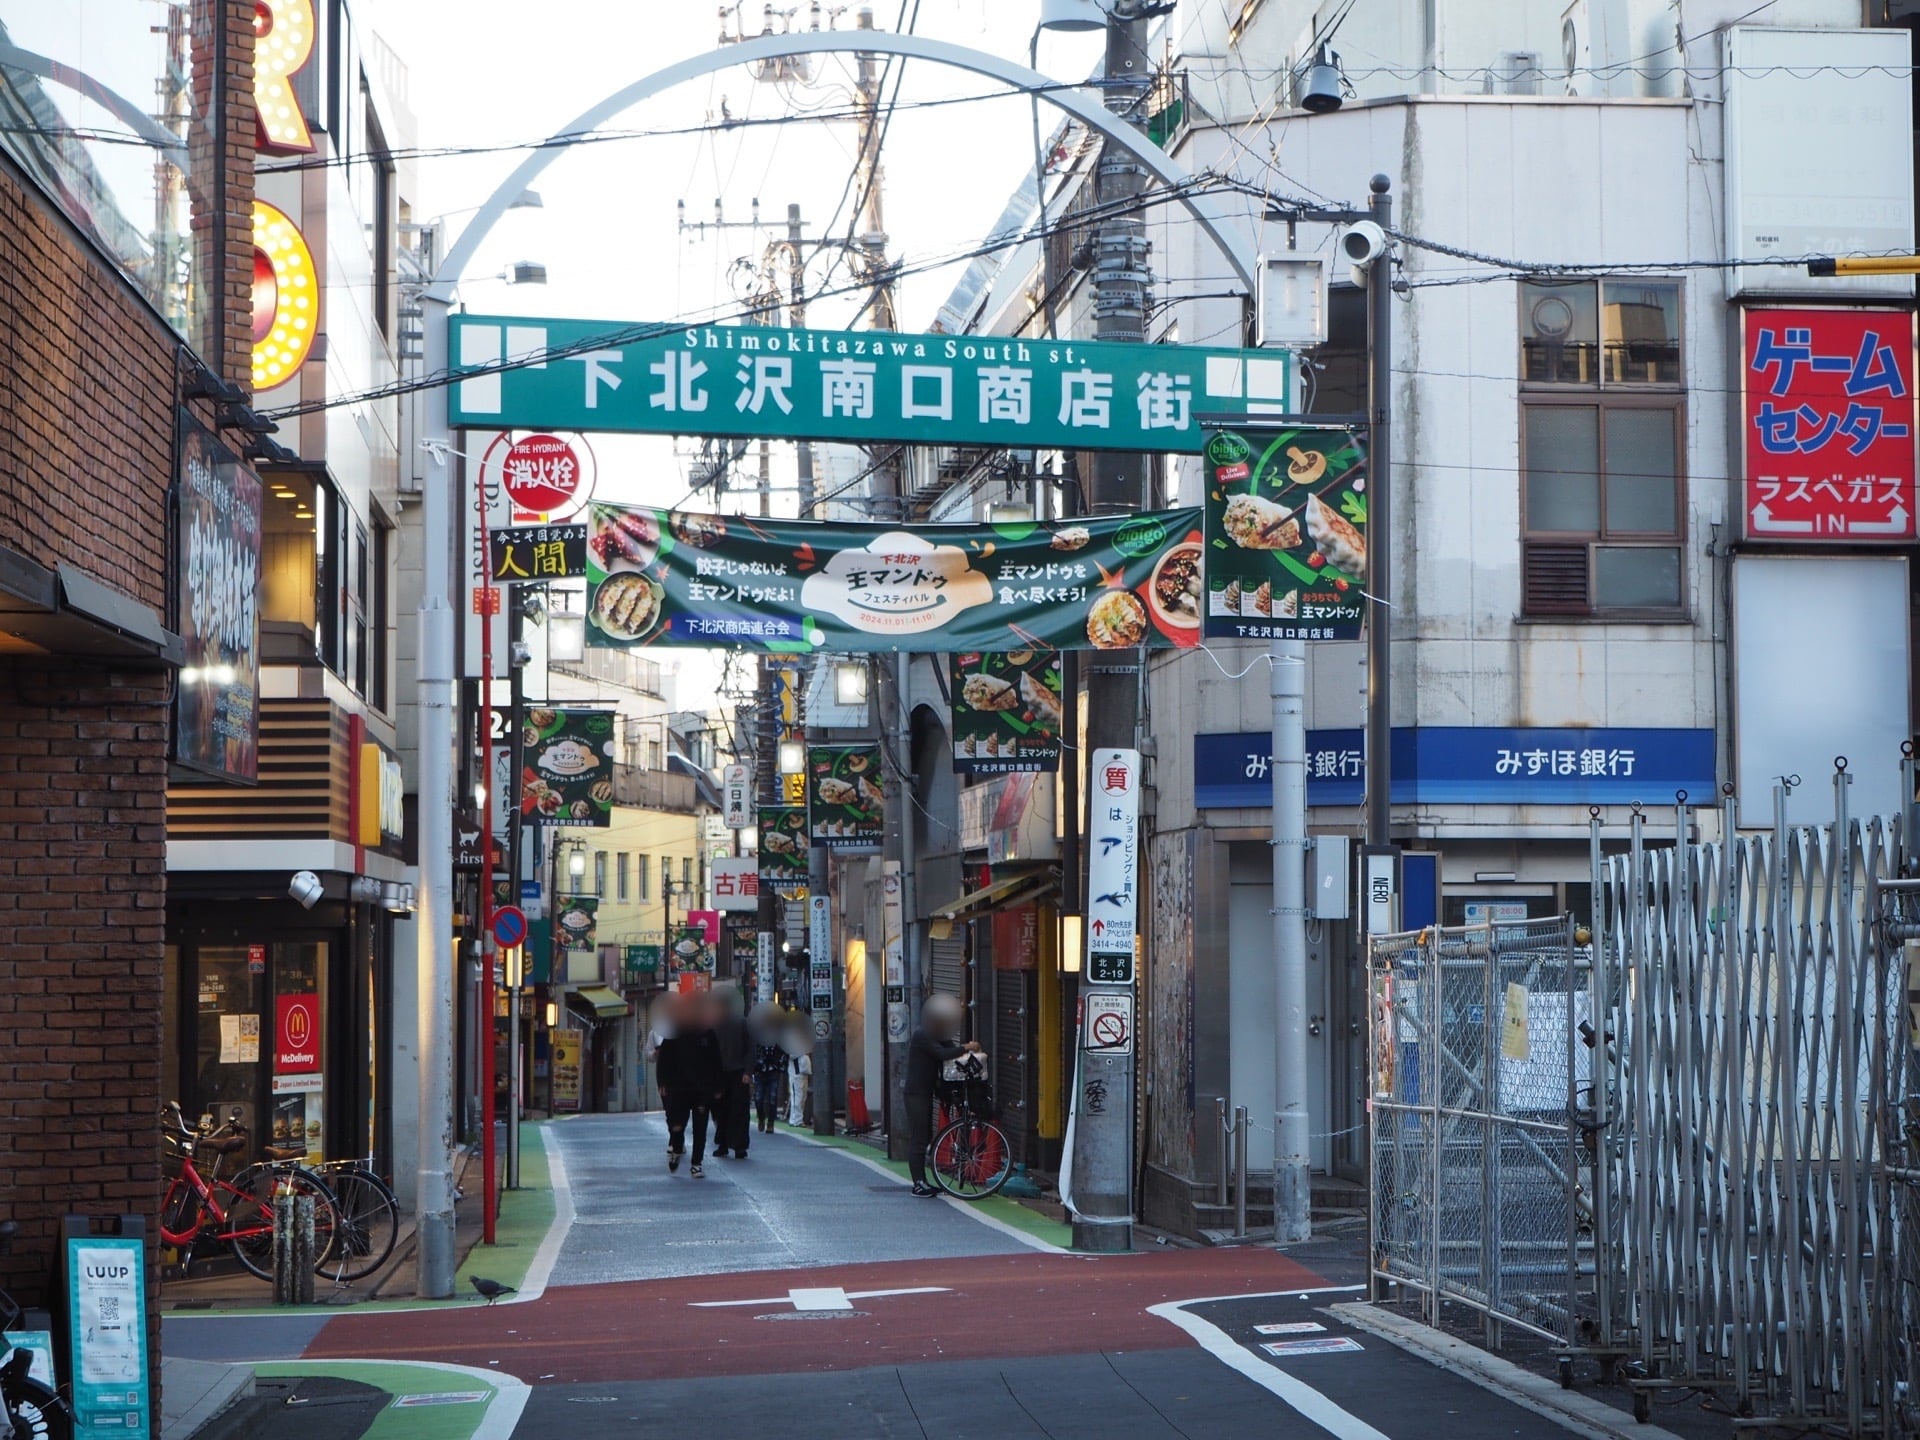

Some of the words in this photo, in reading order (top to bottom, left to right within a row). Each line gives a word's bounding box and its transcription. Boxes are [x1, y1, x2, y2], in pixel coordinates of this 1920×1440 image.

[685, 328, 927, 358] Shimokitazawa
[944, 339, 1031, 363] South
[1049, 348, 1087, 365] st.
[1750, 328, 1907, 399] ゲーム
[569, 350, 1193, 431] 下北沢南口商店街
[1754, 402, 1909, 457] センター
[514, 444, 531, 454] FIRE
[532, 443, 567, 454] HYDRANT
[1212, 441, 1247, 458] bibigo
[508, 456, 576, 490] 消火栓
[1756, 474, 1906, 504] ラスベガス
[1816, 513, 1845, 534] IN
[1117, 527, 1163, 545] bibigo
[496, 541, 567, 577] 人間
[696, 557, 788, 577] 餃子じゃないよ
[880, 554, 922, 566] 下北沢
[845, 569, 949, 591] 王マンドゥ
[998, 563, 1087, 581] 王マンドゥを
[688, 583, 795, 602] 王マンドゥだよ!
[863, 593, 931, 605] フェスティバル
[998, 586, 1087, 604] 食べ尽くそう!
[1302, 606, 1360, 619] 王マンドゥ!
[685, 619, 791, 635] 下北沢商店連合会
[1236, 625, 1335, 639] 下北沢南口商店街
[1019, 747, 1058, 758] 王マンドゥ!
[972, 763, 1042, 772] 下北沢南口商店街
[1494, 747, 1637, 777] みずほ銀行
[1104, 767, 1128, 791] 質
[714, 872, 759, 897] 古着
[1372, 876, 1389, 904] NERO
[1091, 940, 1132, 949] 3414-4940
[1098, 958, 1125, 968] 北沢
[1100, 969, 1124, 978] 2-19
[281, 1053, 314, 1065] McDelivery
[86, 1266, 129, 1279] LUUP
